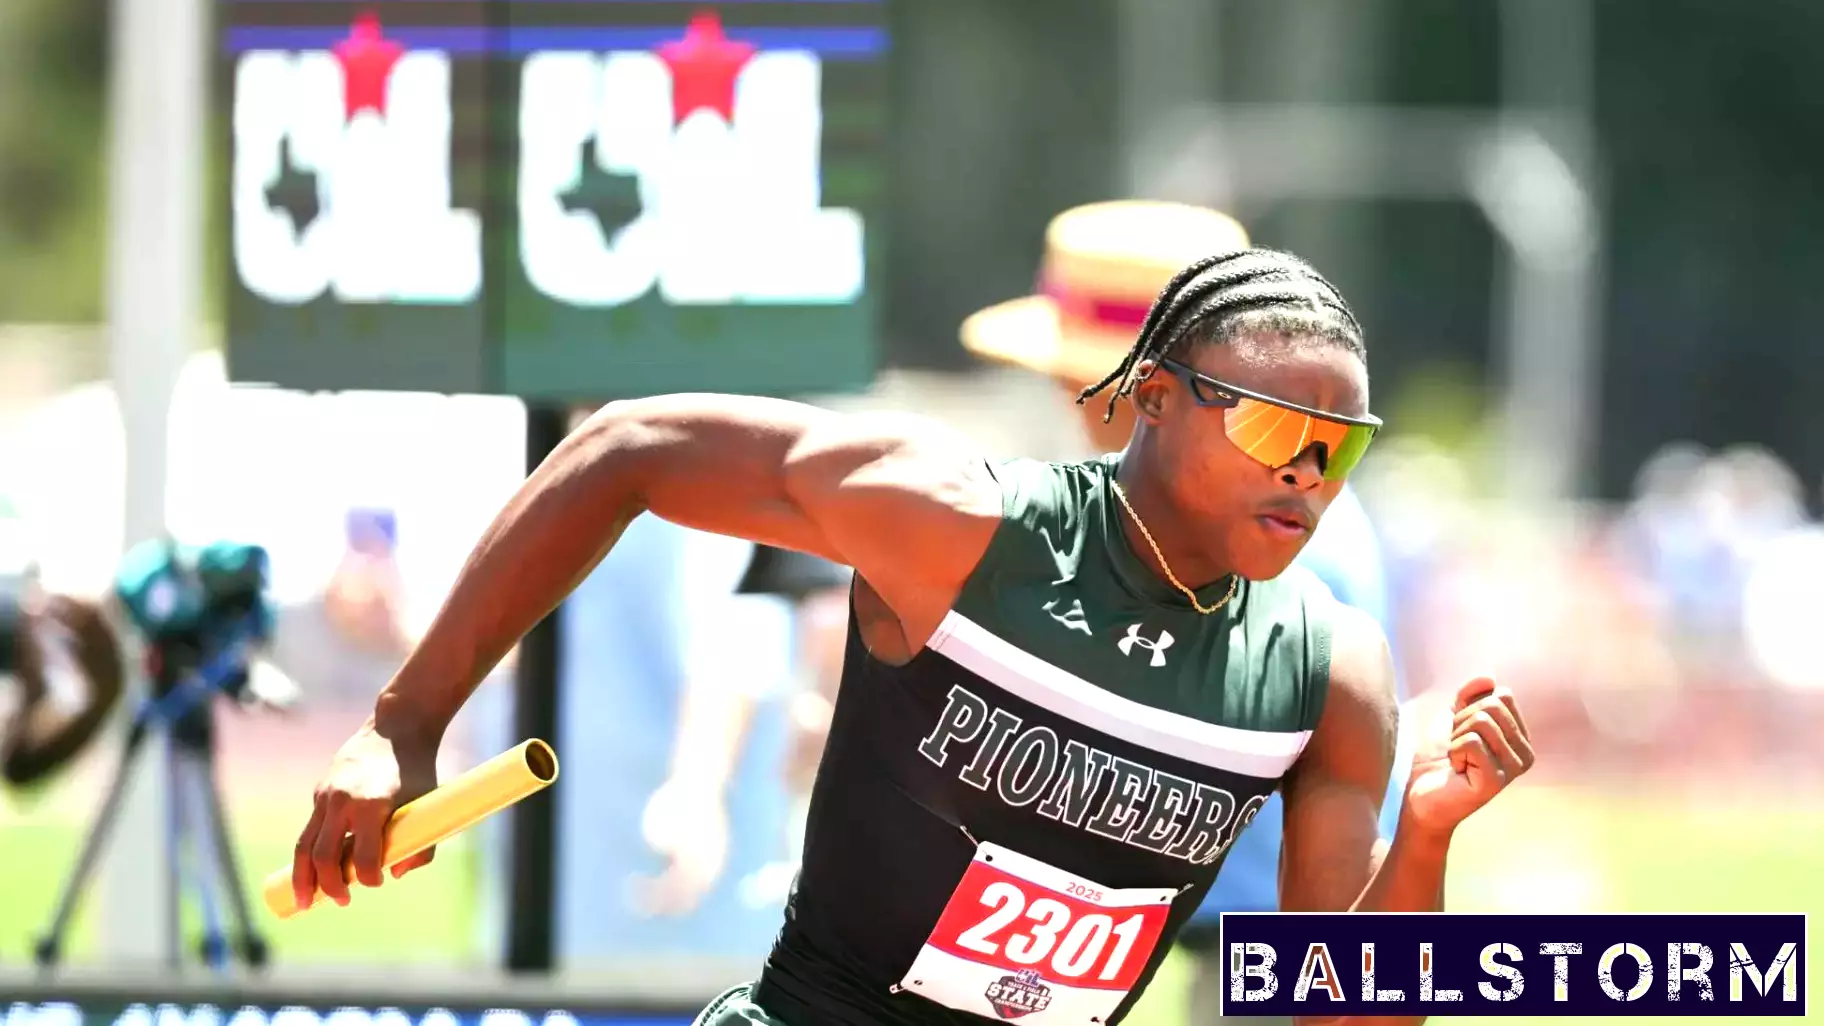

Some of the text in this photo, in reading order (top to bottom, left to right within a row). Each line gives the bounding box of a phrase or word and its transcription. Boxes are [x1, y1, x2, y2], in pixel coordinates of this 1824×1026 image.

[1065, 881, 1104, 901] 2025
[956, 882, 1145, 981] 2301
[988, 982, 1051, 1010] STATE
